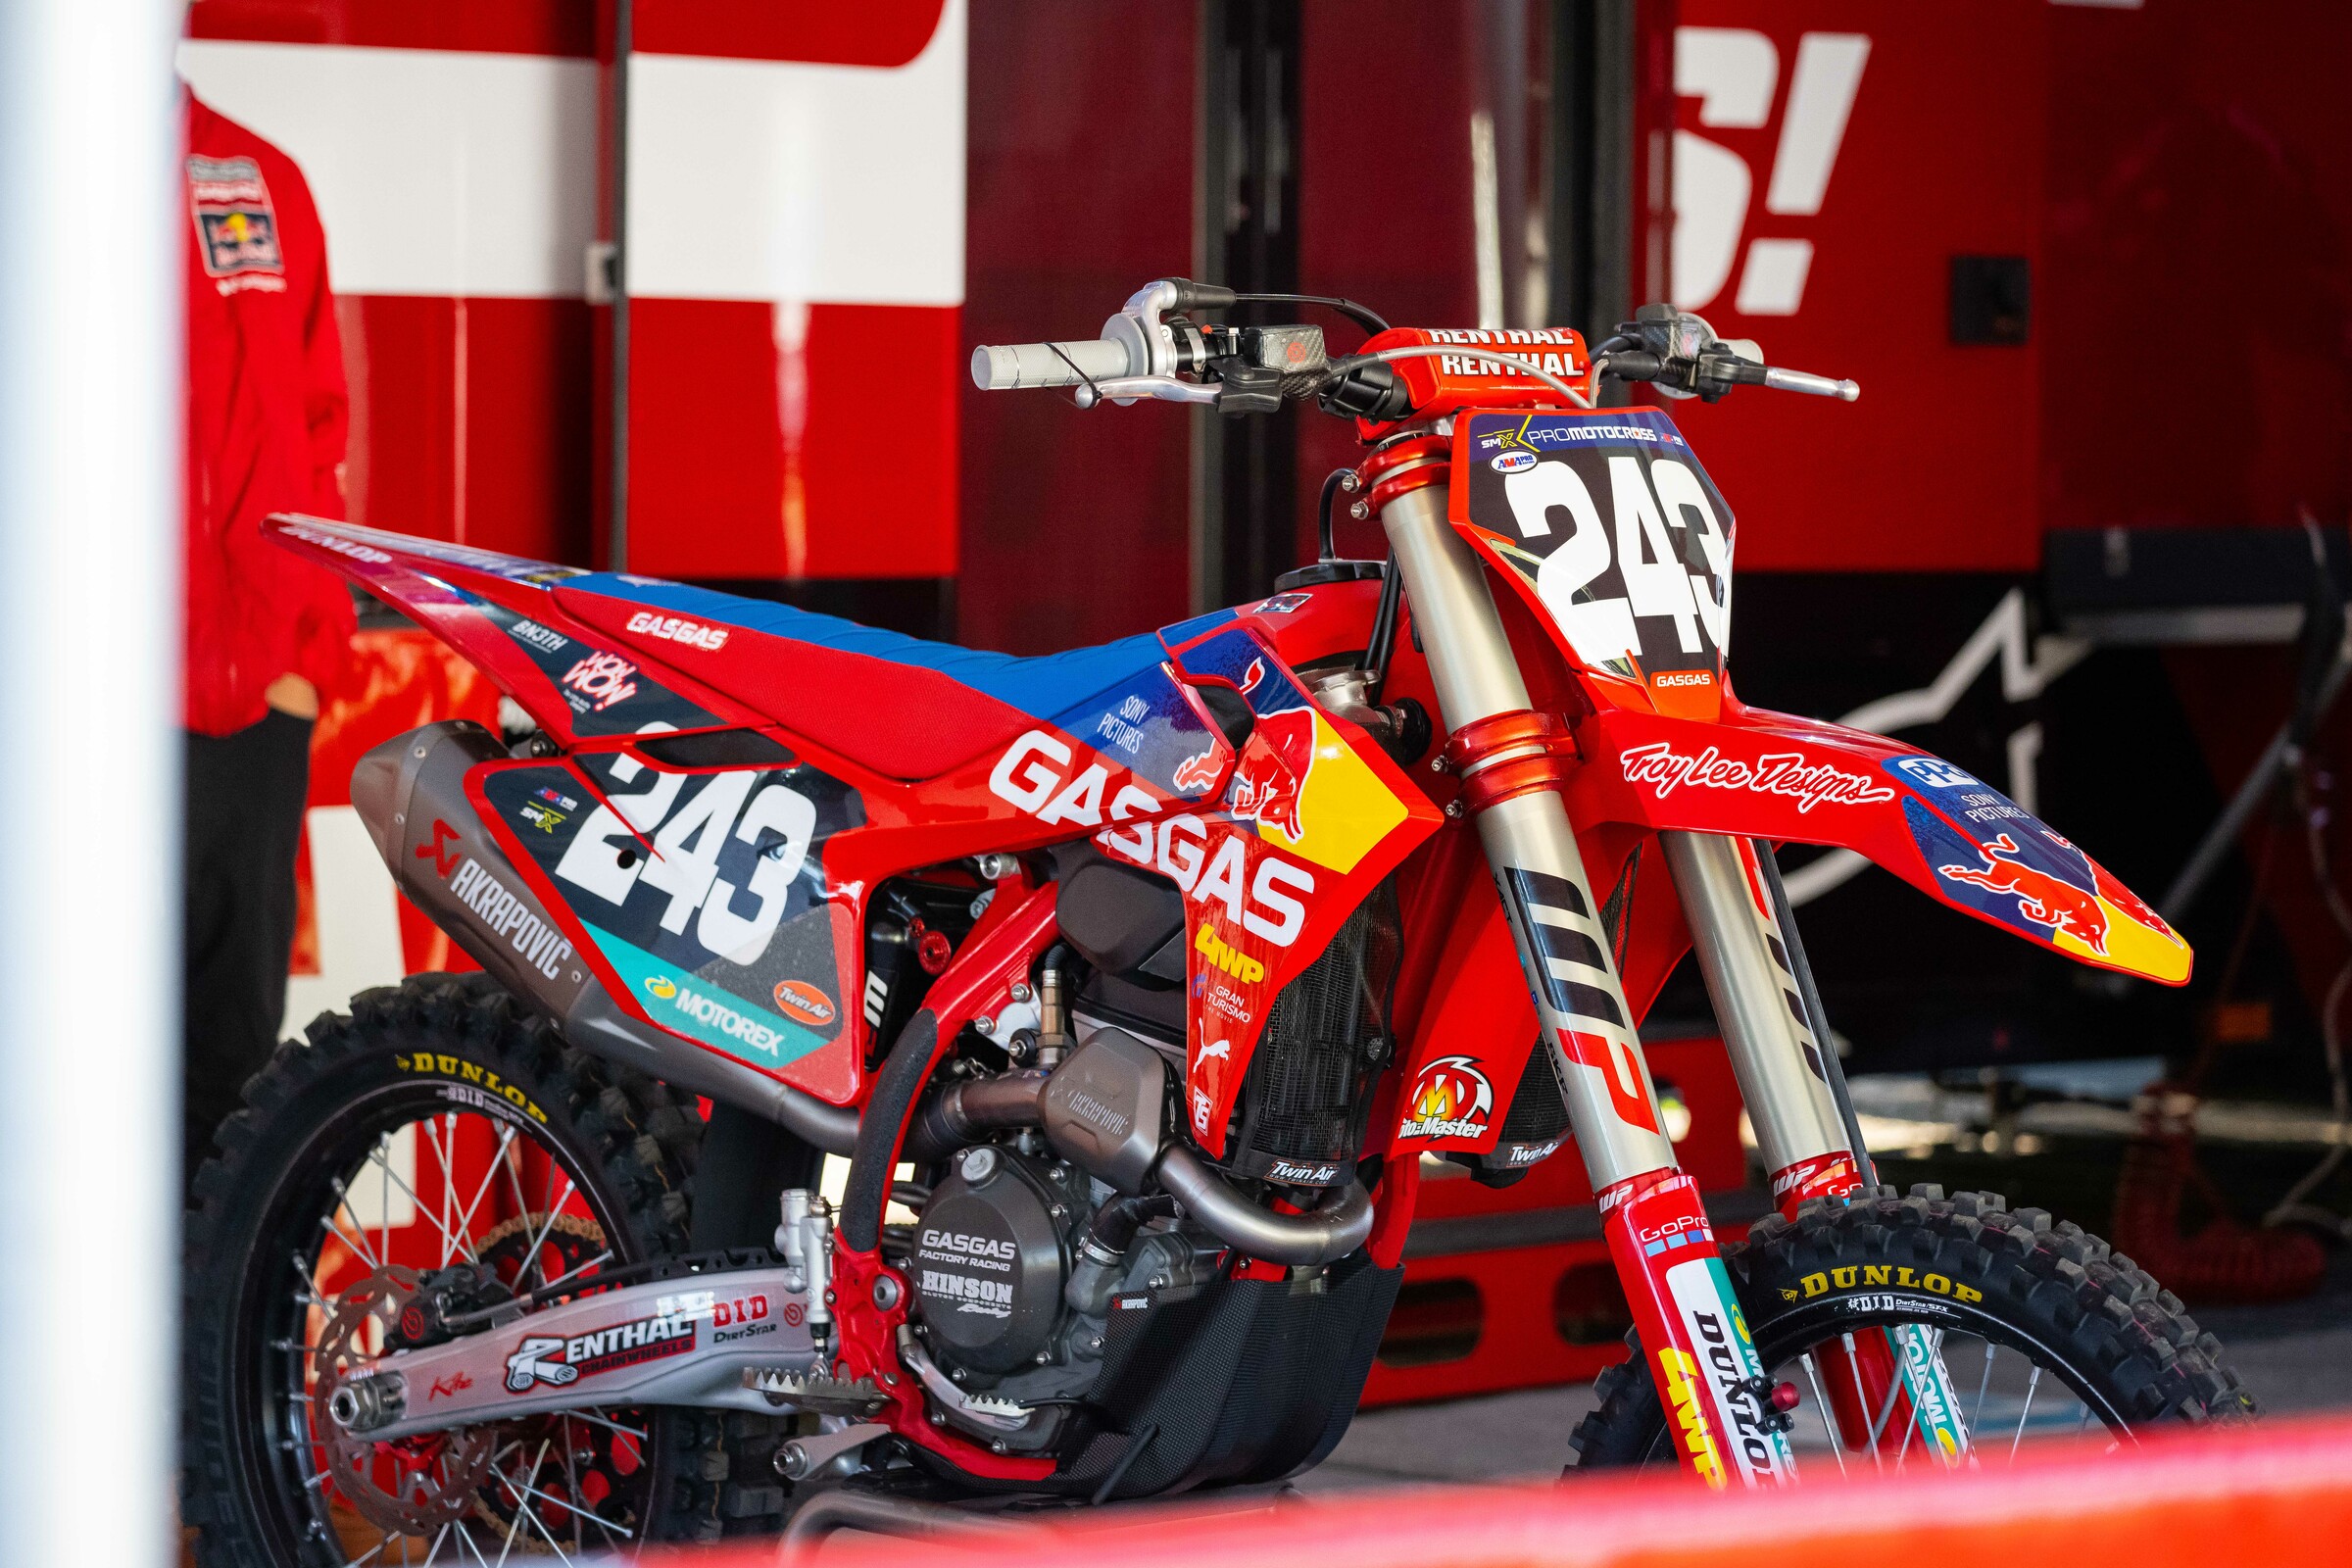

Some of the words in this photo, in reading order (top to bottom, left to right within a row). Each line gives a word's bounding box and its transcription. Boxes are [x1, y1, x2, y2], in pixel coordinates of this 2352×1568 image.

[1441, 352, 1585, 376] RENTHAL
[1497, 457, 1522, 469] AMA
[1504, 456, 1736, 662] 243
[512, 620, 568, 652] BN3TH
[626, 612, 729, 651] GASGAS
[1656, 673, 1711, 687] GASGAS
[1119, 695, 1151, 725] SONY
[1097, 711, 1145, 755] PICTURES
[1620, 741, 1691, 799] Troy
[1683, 746, 1751, 790] Lee
[1748, 752, 1895, 814] Designs
[1961, 793, 2000, 807] SONY
[1964, 806, 2031, 823] PICTURES
[554, 719, 817, 966] 243
[988, 729, 1316, 948] GASGAS
[1194, 922, 1265, 985] 4WP
[779, 986, 811, 1010] Twin
[807, 1003, 832, 1018] Air
[1207, 992, 1251, 1024] TURISMO
[1215, 985, 1246, 1008] GRAN
[674, 988, 786, 1058] MOTOREX
[413, 1052, 548, 1124] DUNLOP
[1510, 1146, 1543, 1161] Twin
[1271, 1160, 1314, 1180] Twin
[1310, 1165, 1338, 1181] Air
[1773, 1163, 1817, 1198] WP
[1598, 1184, 1634, 1214] WP
[921, 1228, 1017, 1260] GASGAS
[1640, 1215, 1709, 1243] GoPro
[918, 1249, 969, 1265] FACTORY
[968, 1256, 1011, 1272] RACING
[921, 1269, 1014, 1304] HINSON
[1800, 1264, 1984, 1304] DUNLOP
[581, 1338, 693, 1372] CHAINWHEELS
